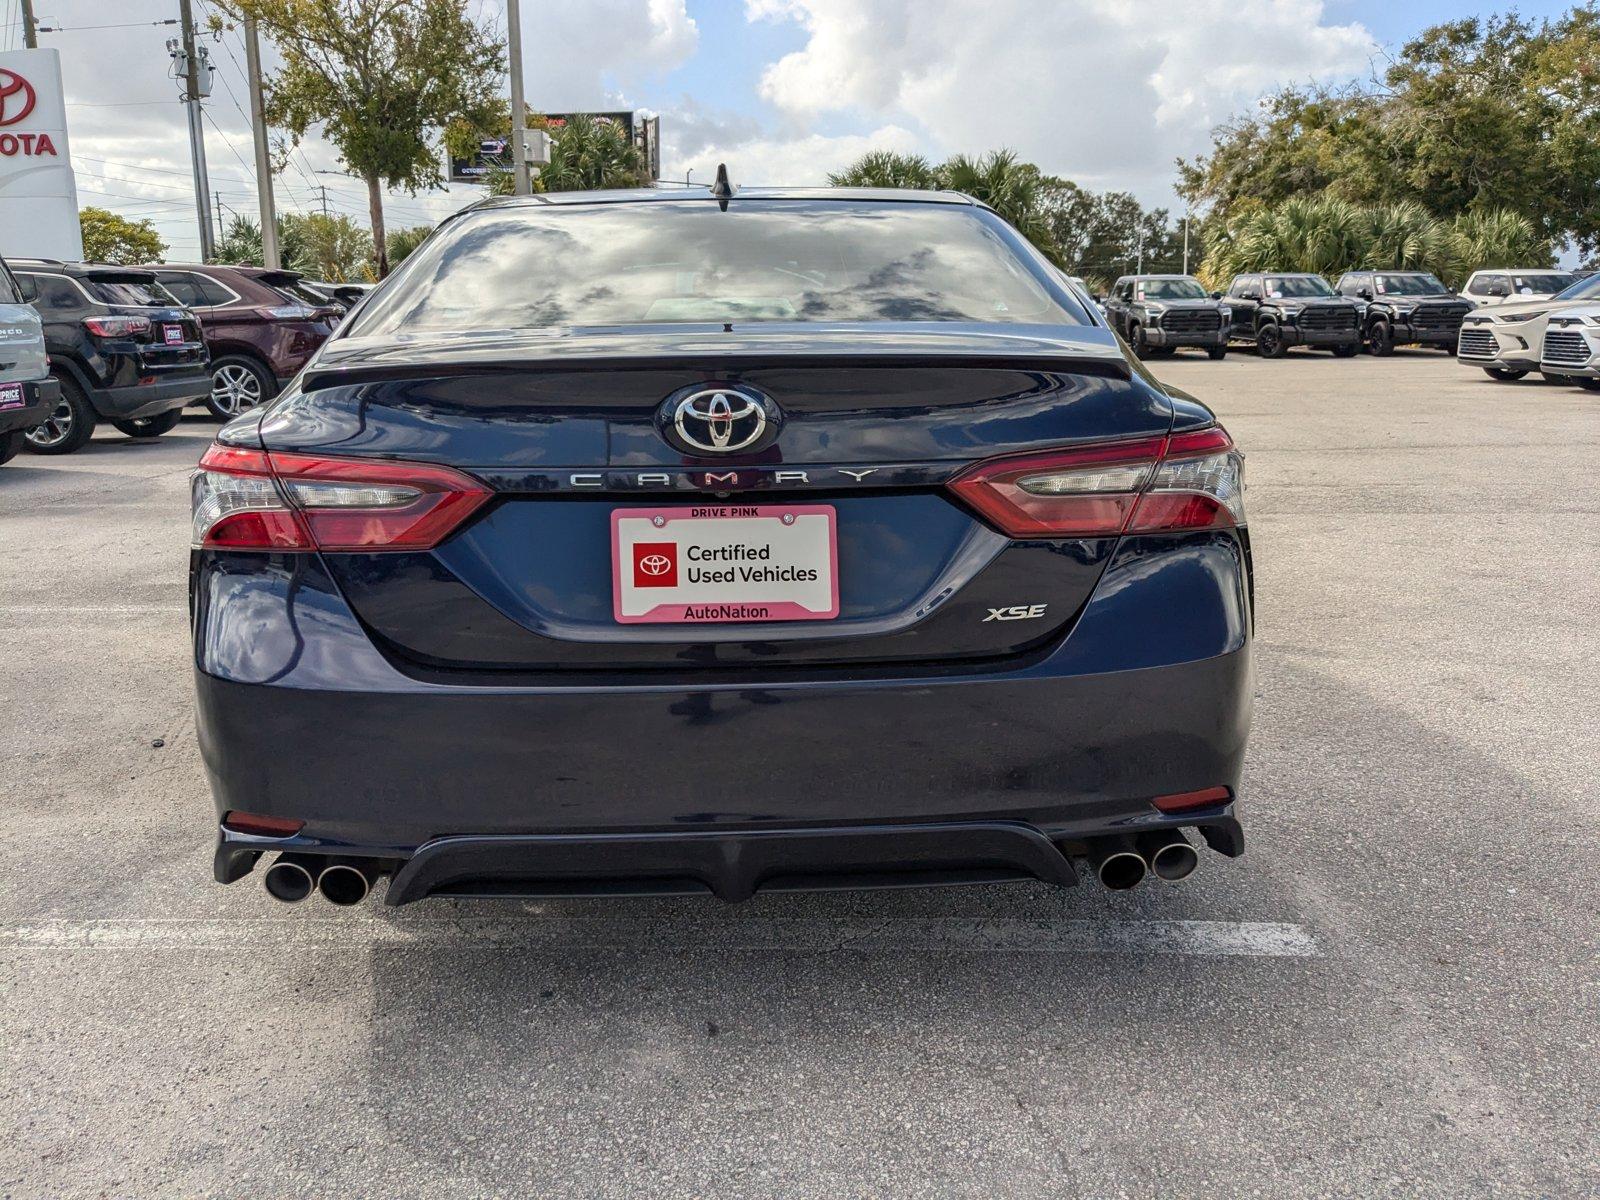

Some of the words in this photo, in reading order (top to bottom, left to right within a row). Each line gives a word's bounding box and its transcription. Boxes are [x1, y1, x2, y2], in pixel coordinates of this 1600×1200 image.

[570, 468, 879, 486] CAMRY
[691, 508, 727, 517] DRIVE
[731, 507, 759, 517] PINK
[687, 544, 770, 561] Certified
[687, 567, 735, 583] Used
[739, 566, 818, 582] Vehicles
[684, 605, 768, 619] AutoNation
[982, 603, 1048, 622] XSE
